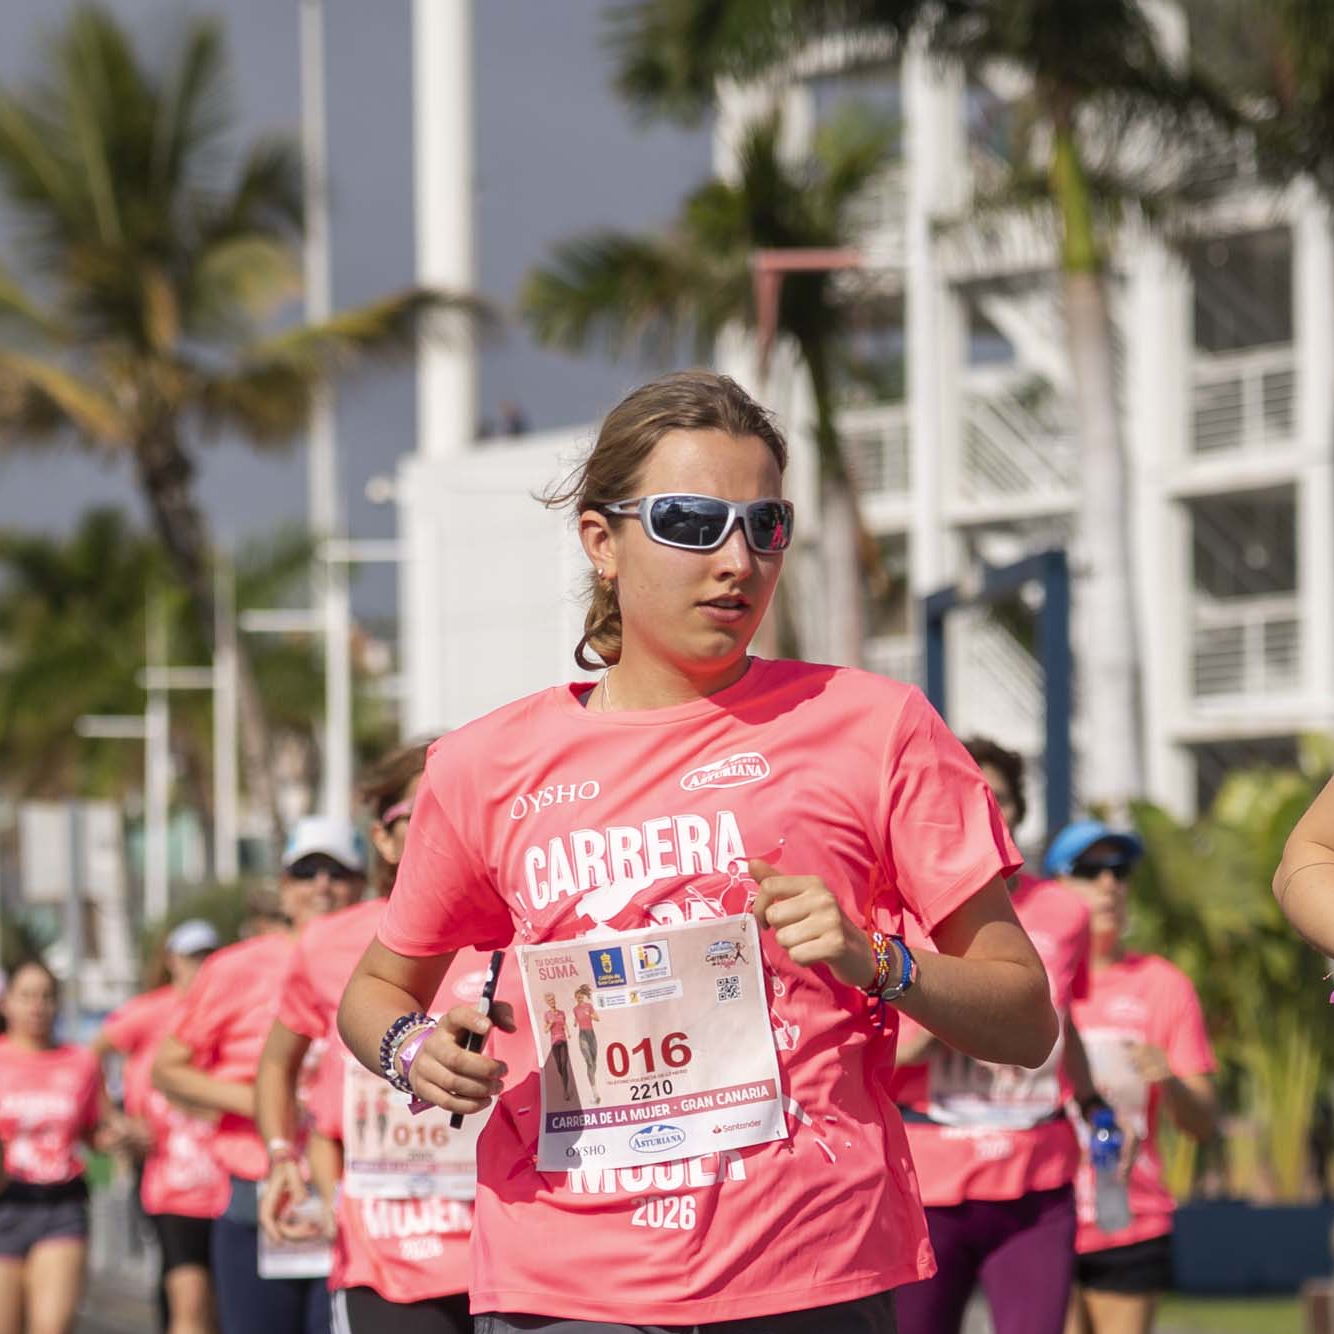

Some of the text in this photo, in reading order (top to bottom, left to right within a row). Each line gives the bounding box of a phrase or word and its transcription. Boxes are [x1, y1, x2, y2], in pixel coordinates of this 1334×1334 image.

[510, 781, 600, 819] OYSHO
[525, 811, 749, 910] CARRERA
[538, 964, 579, 980] SUMA
[606, 1032, 692, 1077] 016
[630, 1080, 673, 1101] 2210
[552, 1084, 769, 1129] CARRERA DE LA MUJER GRAN CANARIA
[393, 1124, 449, 1147] 016
[723, 1120, 762, 1133] Santander
[566, 1144, 606, 1158] OYSHO
[633, 1134, 683, 1149] ASTURIANA
[632, 1195, 696, 1230] 2026
